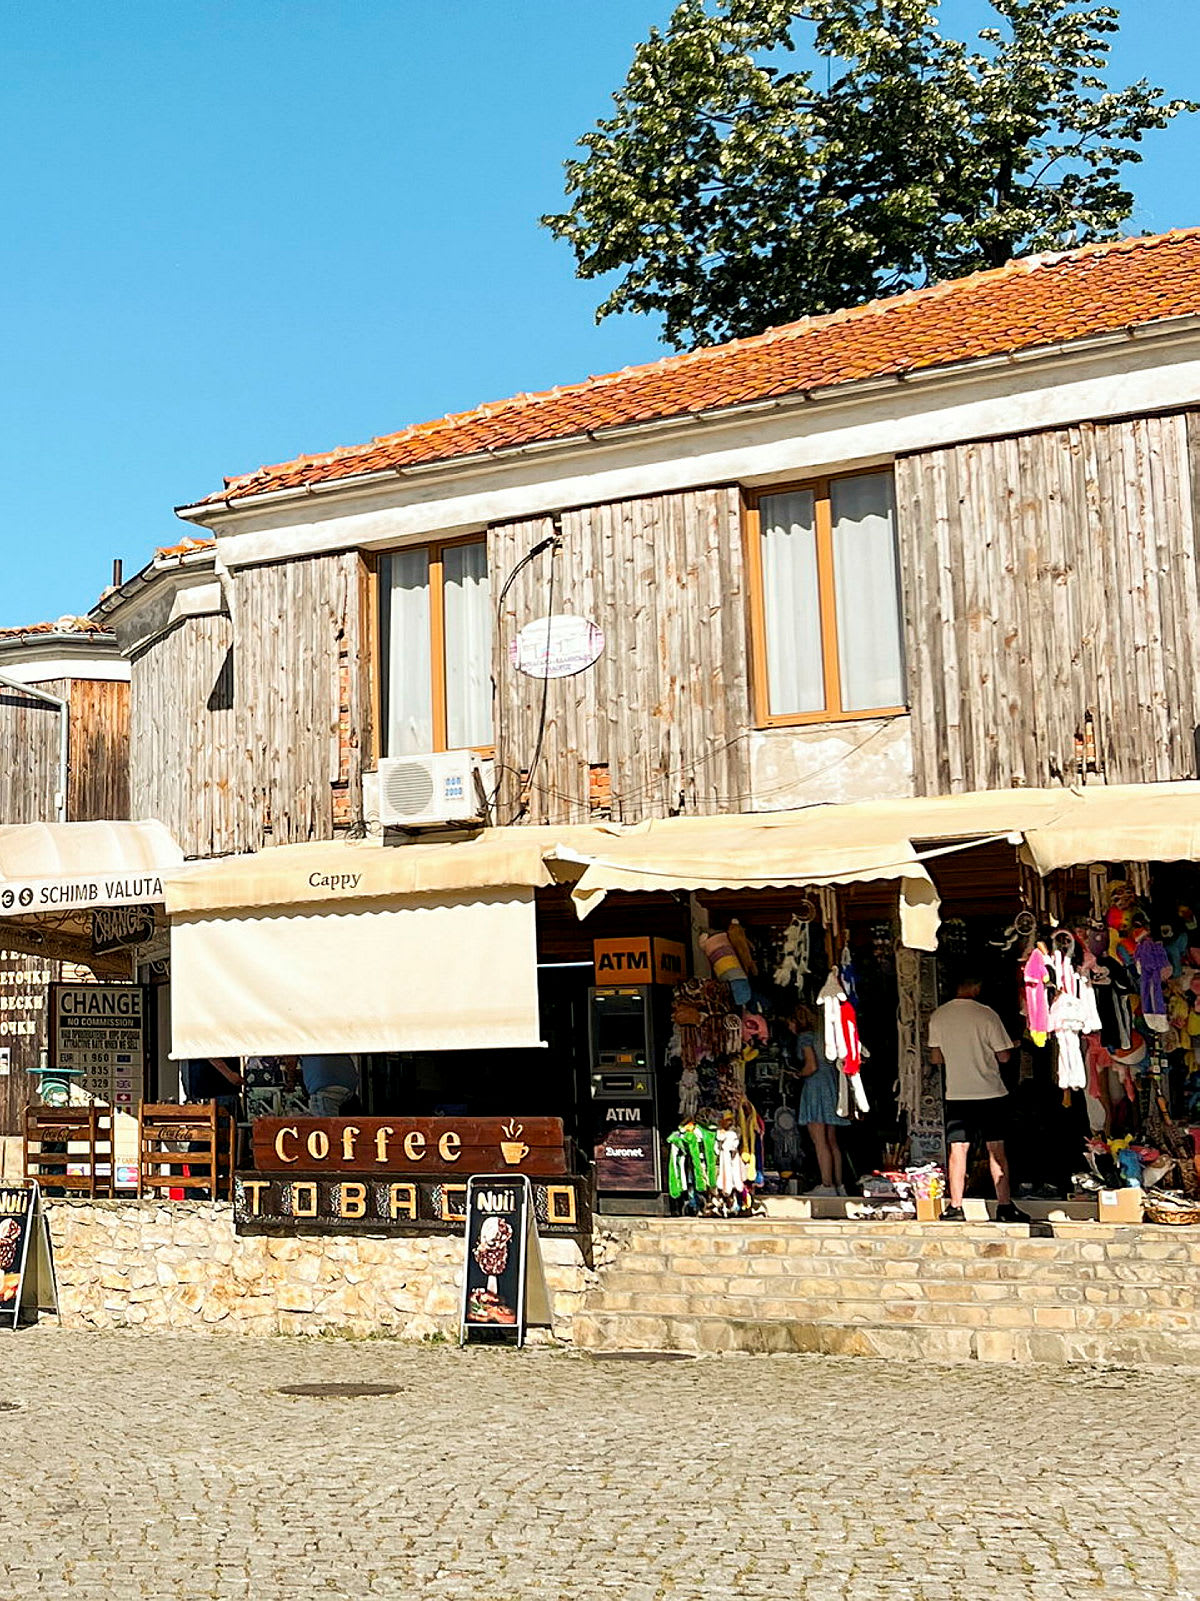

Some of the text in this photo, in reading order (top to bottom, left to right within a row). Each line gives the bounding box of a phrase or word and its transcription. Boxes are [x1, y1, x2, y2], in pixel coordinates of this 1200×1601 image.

[40, 884, 98, 904] SCHIMB
[105, 878, 163, 898] VALUTA
[309, 872, 362, 890] Cappy
[599, 951, 648, 970] ATM
[661, 952, 681, 973] ATM
[61, 992, 140, 1014] CHANGE
[68, 1018, 134, 1027] NO COMMISSION
[606, 1108, 641, 1121] ATM
[275, 1126, 461, 1163] Coffee
[243, 1181, 576, 1223] TOBACO
[477, 1190, 516, 1212] Nuii
